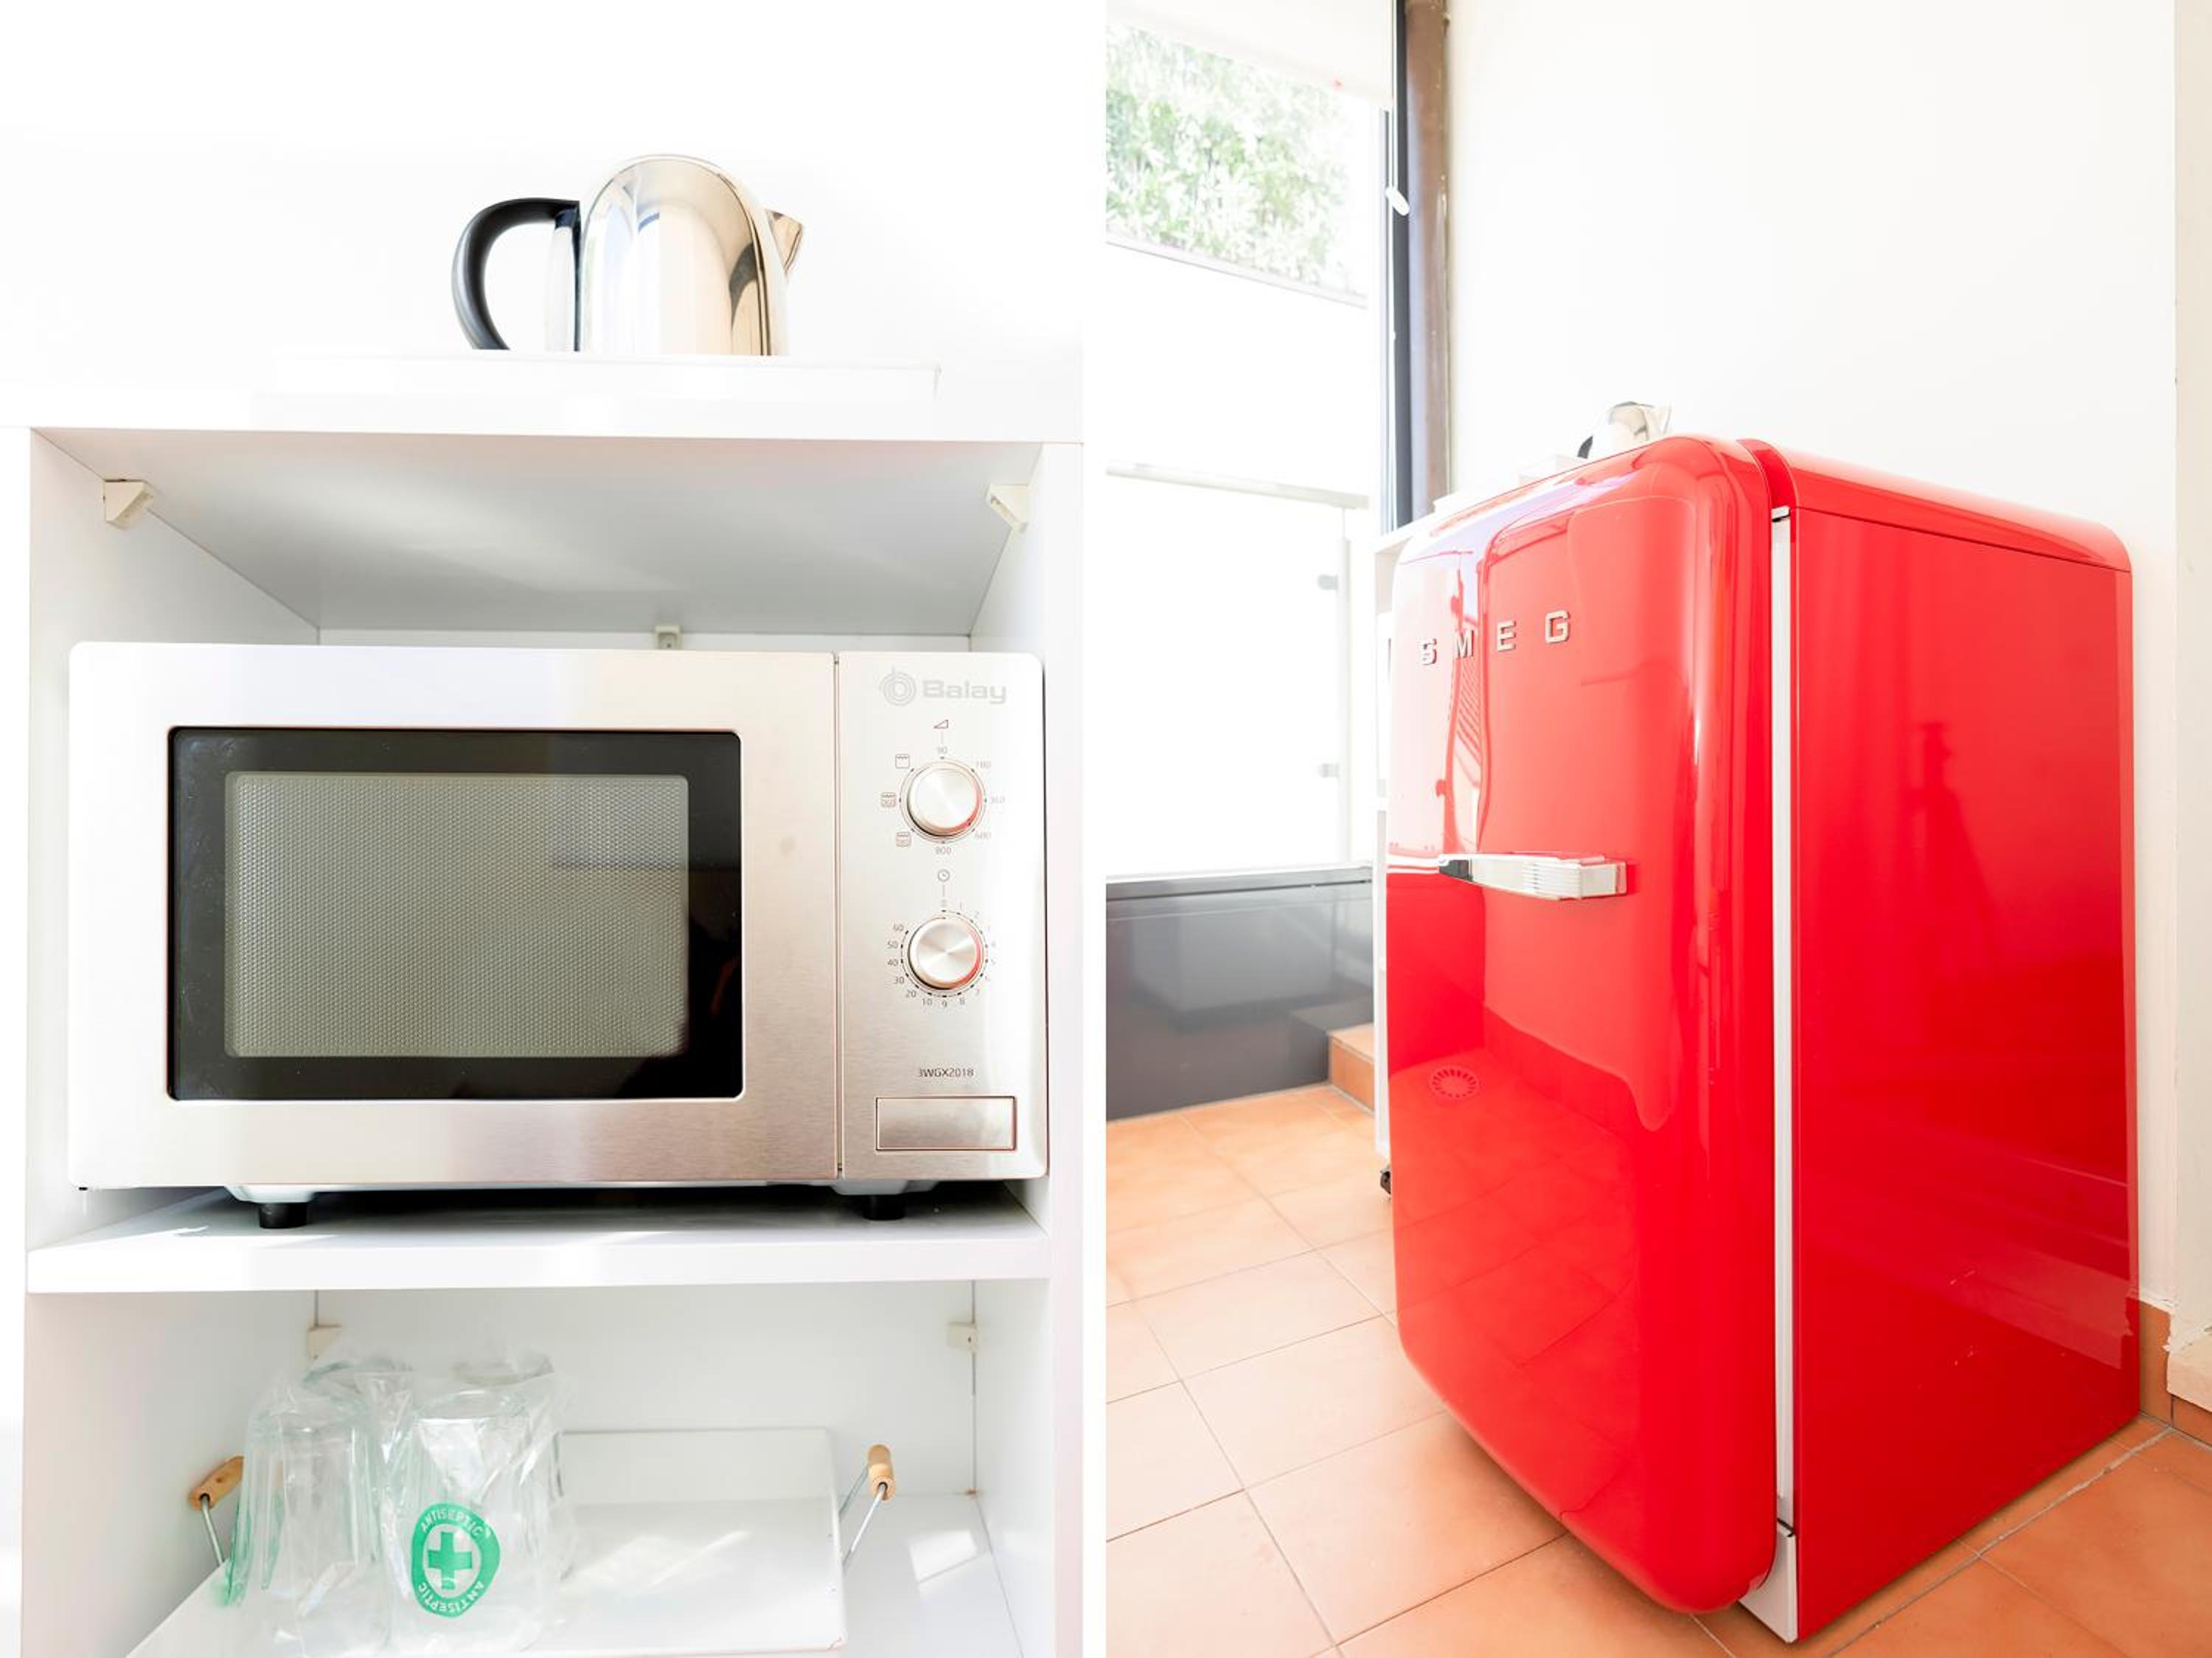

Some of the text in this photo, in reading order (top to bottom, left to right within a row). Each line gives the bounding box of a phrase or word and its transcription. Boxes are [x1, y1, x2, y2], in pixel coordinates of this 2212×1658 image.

[1419, 609, 1570, 665] SMEG
[923, 679, 1006, 704] Balay
[887, 940, 899, 949] 50
[887, 958, 899, 967] 40
[893, 976, 905, 985] 30
[905, 990, 917, 998] 20
[922, 997, 933, 1006] 10
[917, 1067, 974, 1078] 3WGX2018
[420, 1509, 484, 1534] ANTISEPTIC
[418, 1581, 484, 1613] ANTISEPTIC
